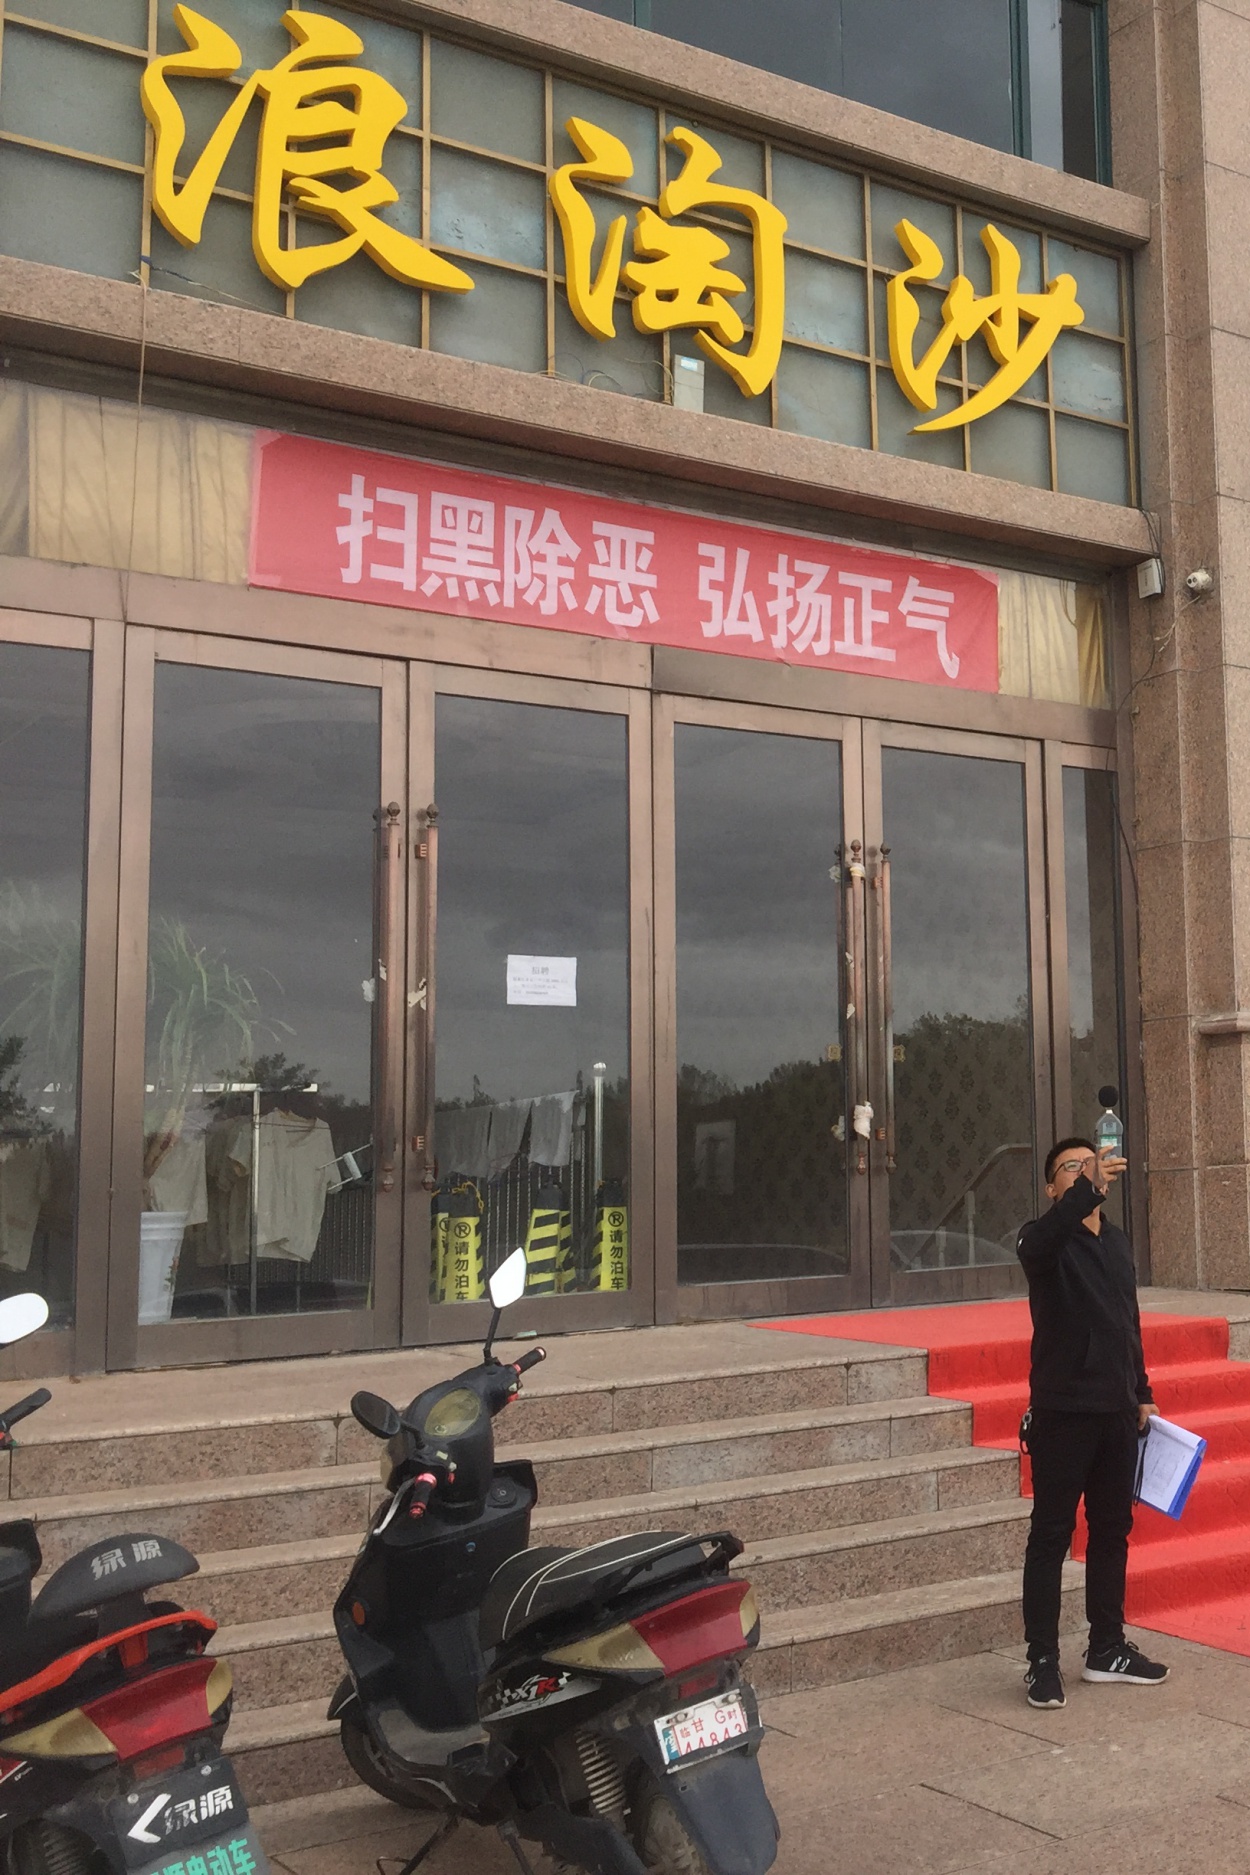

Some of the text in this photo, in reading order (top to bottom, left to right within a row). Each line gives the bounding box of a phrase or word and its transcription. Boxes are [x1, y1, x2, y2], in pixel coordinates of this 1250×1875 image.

[140, 3, 1085, 435] 浪淘沙
[336, 473, 960, 680] 扫黑除恶 弘扬正气
[455, 1241, 469, 1300] 请勿泊车
[609, 1229, 624, 1290] 请勿泊车
[90, 1539, 163, 1580] 绿源
[164, 1785, 234, 1836] 绿源
